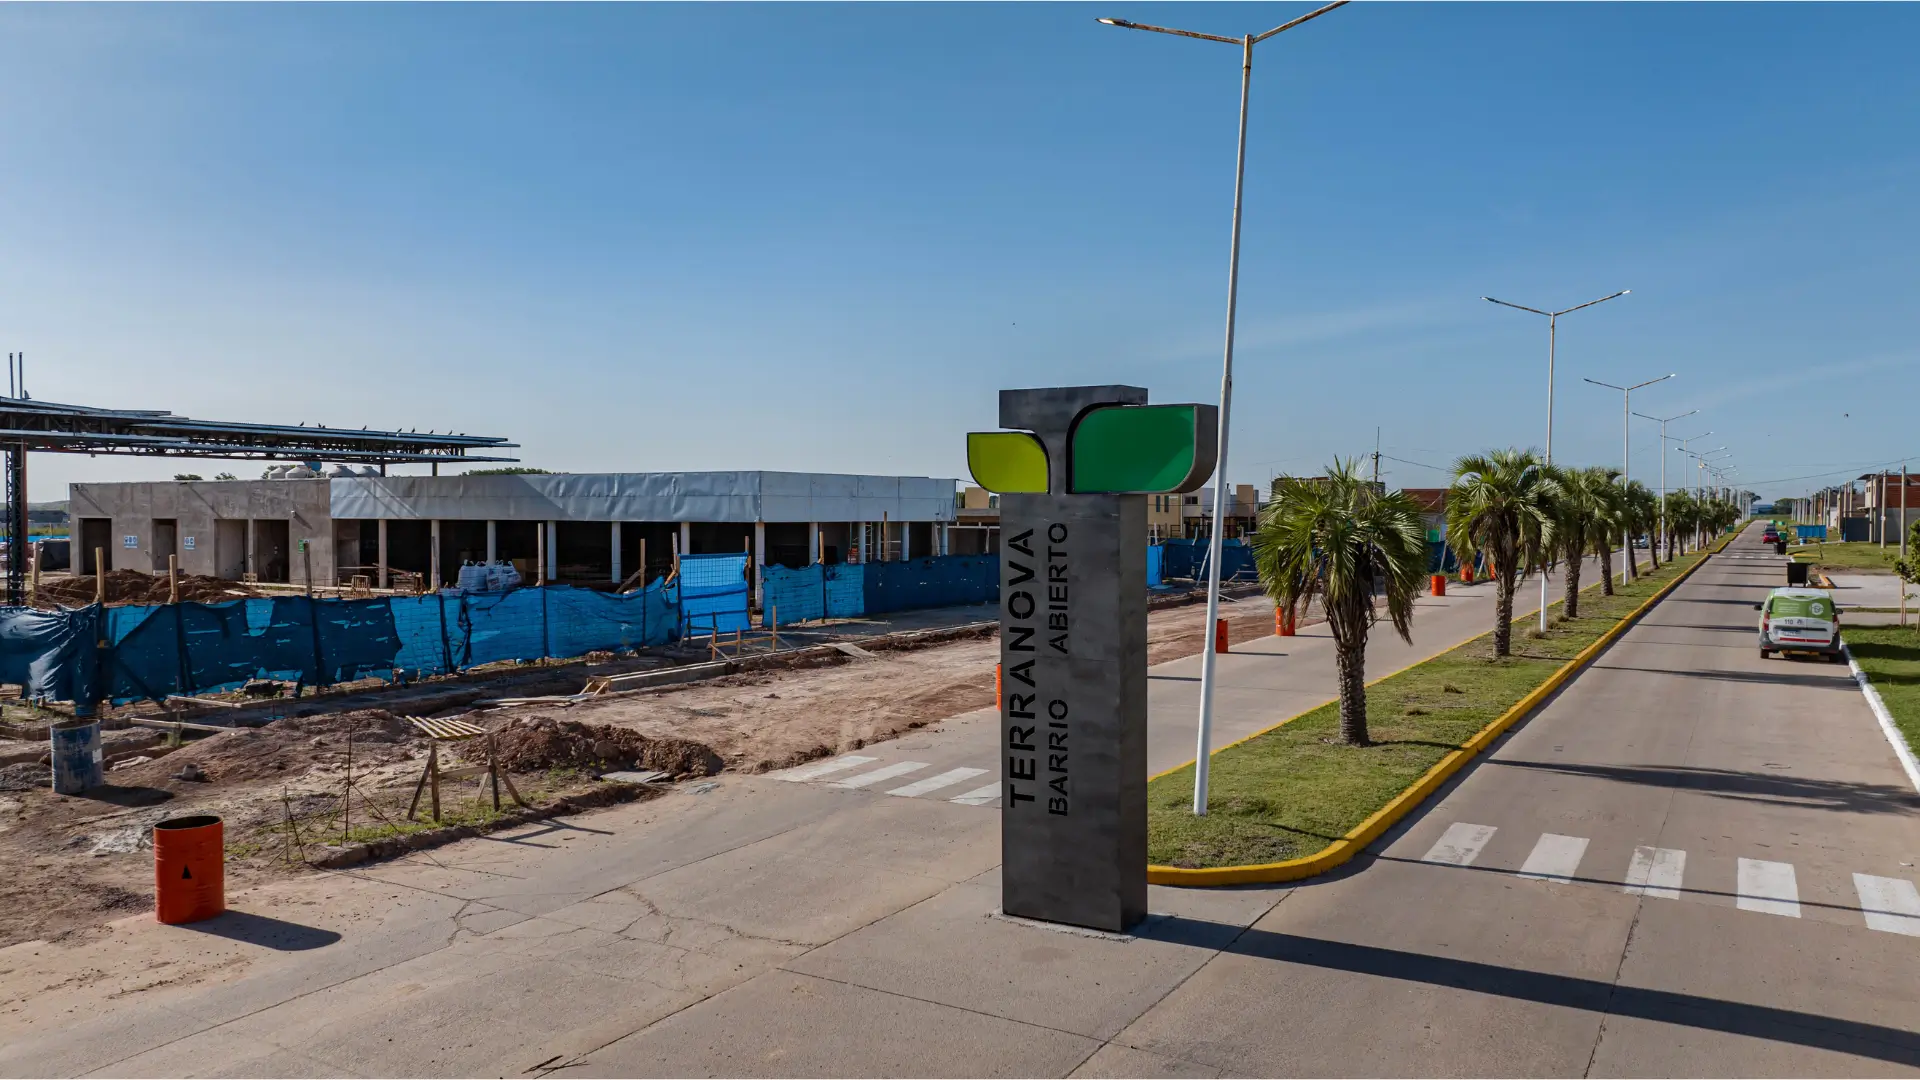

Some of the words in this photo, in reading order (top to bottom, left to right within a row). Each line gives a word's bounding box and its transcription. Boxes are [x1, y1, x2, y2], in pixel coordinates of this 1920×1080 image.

[1047, 522, 1068, 655] ABIERTO
[1008, 527, 1036, 809] TERRANOVA
[1048, 699, 1068, 817] BARRIO
